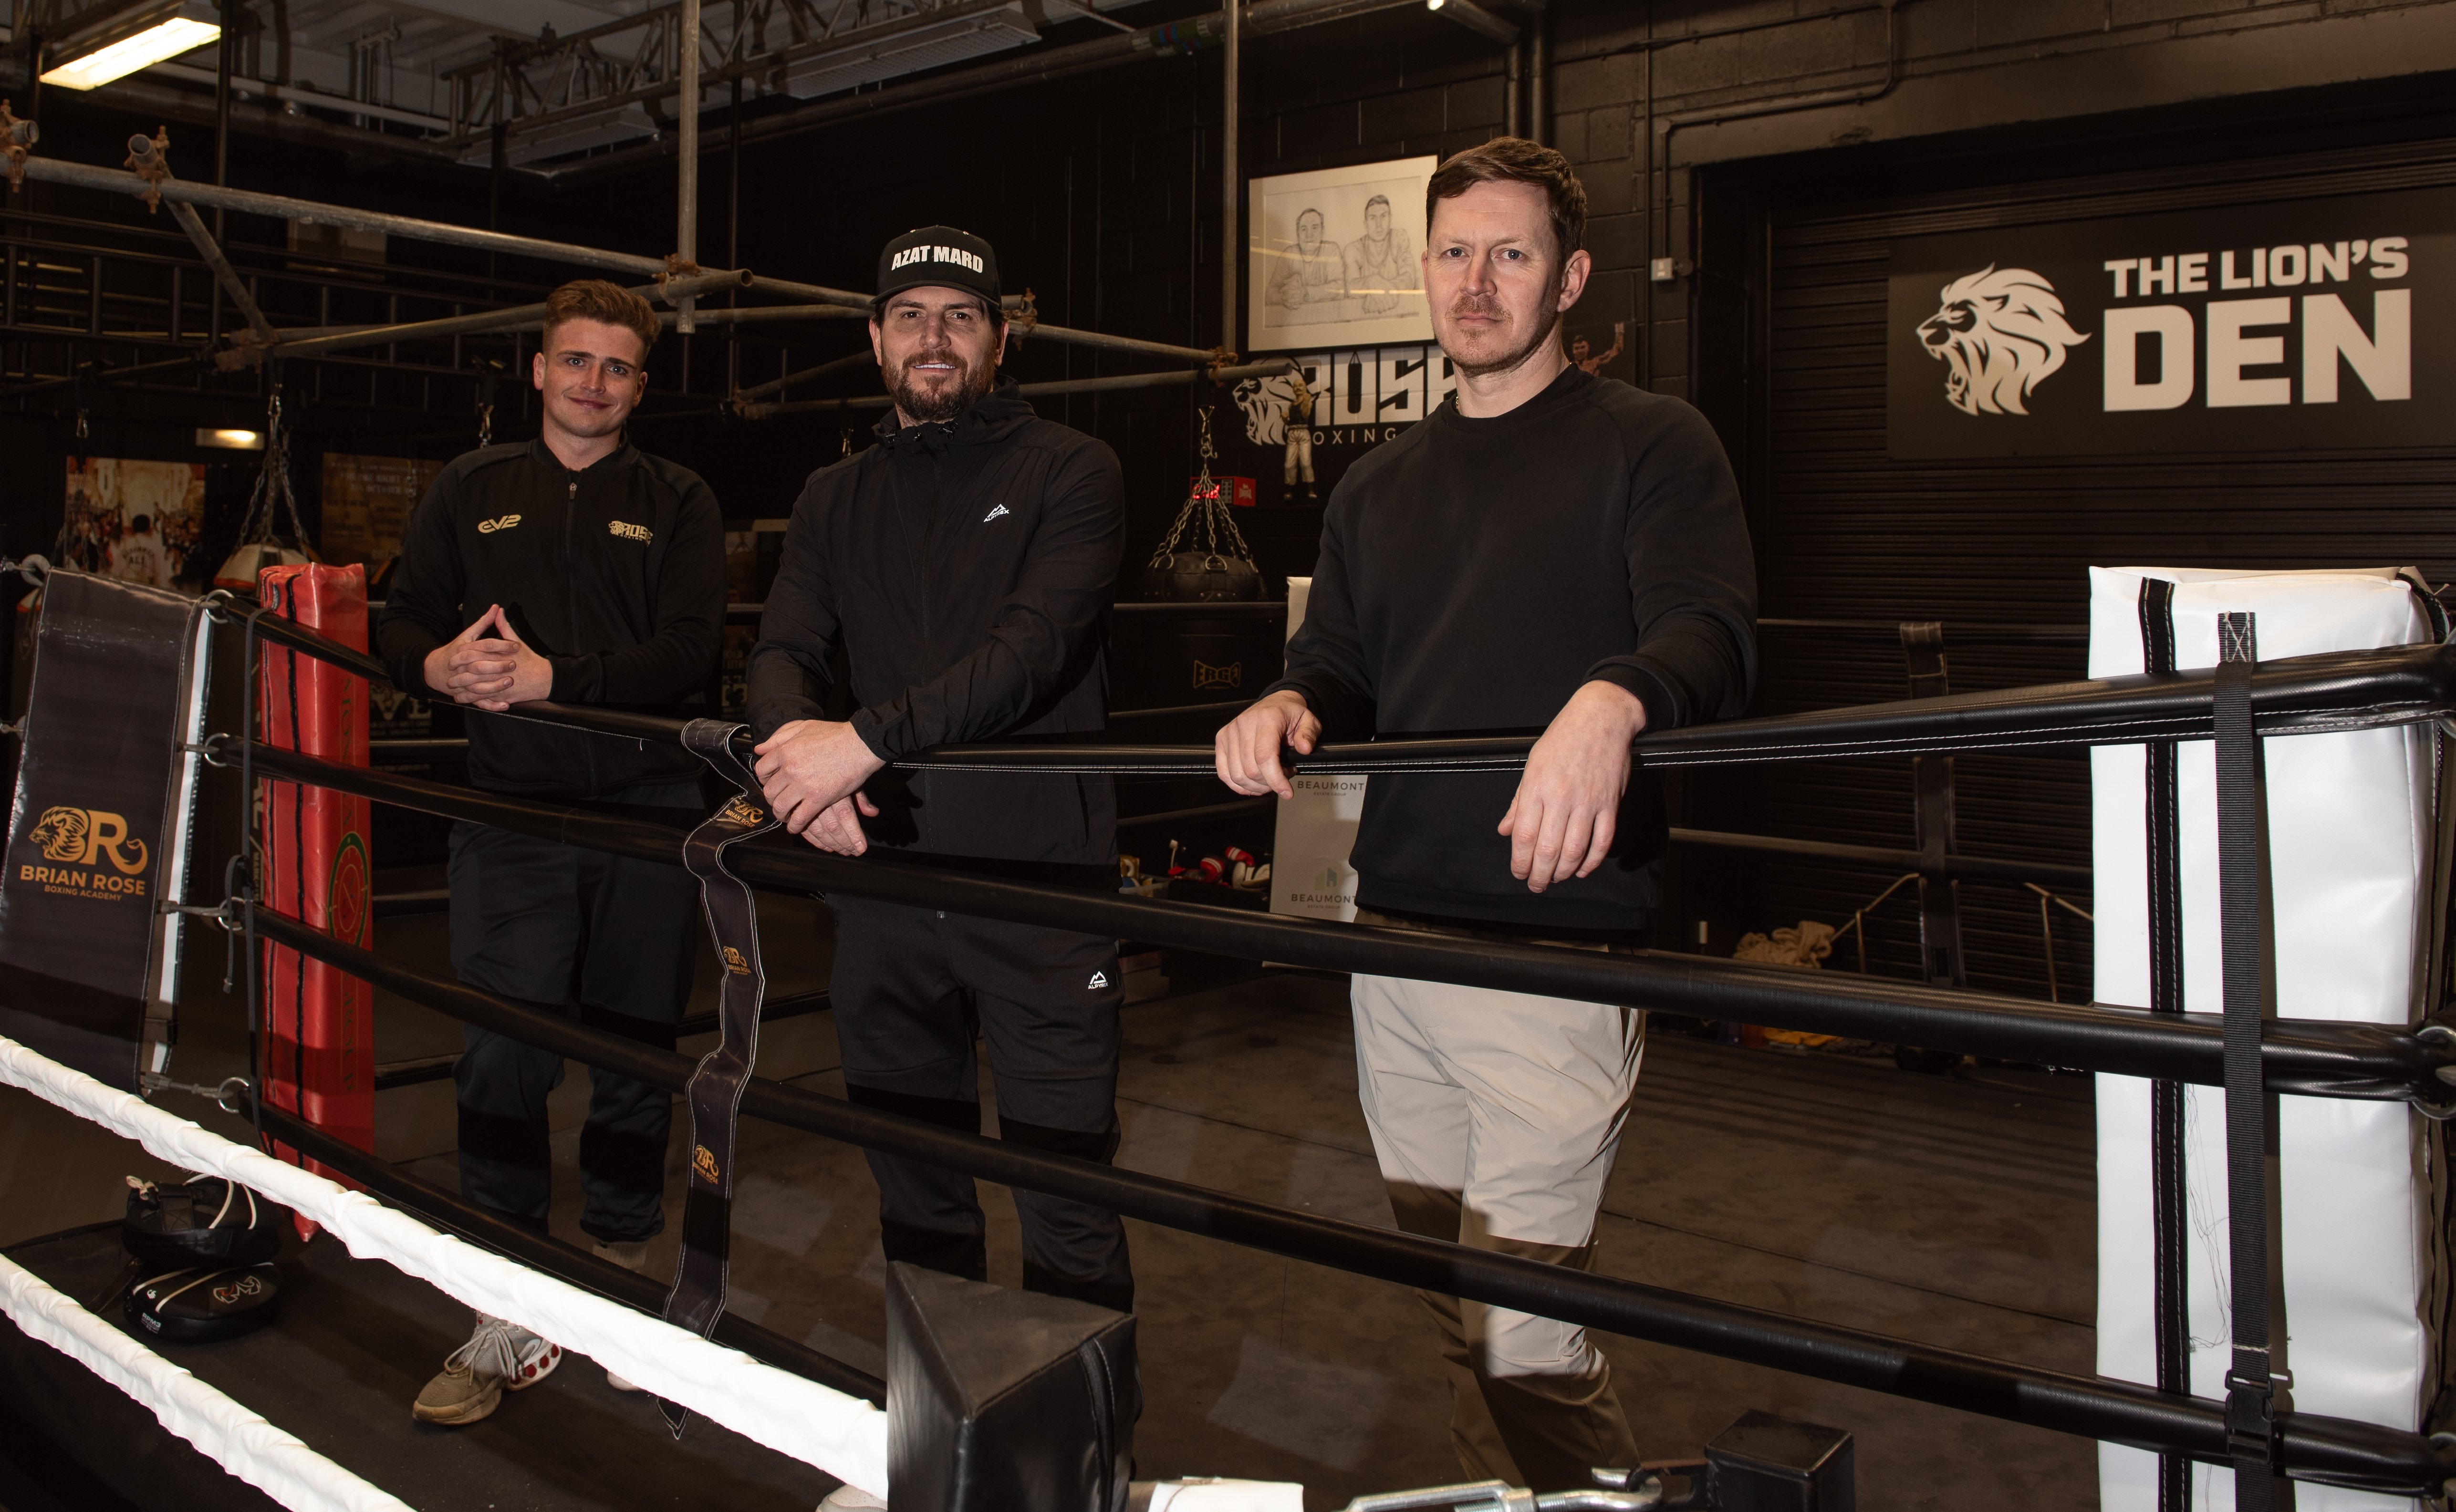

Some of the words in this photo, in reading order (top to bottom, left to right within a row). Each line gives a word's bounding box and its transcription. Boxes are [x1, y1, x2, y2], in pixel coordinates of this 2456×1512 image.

[891, 245, 931, 271] AZAT
[933, 246, 983, 274] MARD
[2104, 252, 2209, 299] THE
[2220, 236, 2409, 290] LION'S
[2102, 288, 2412, 413] DEN
[1311, 426, 1397, 446] OXING
[1297, 780, 1364, 791] BEAUMONT
[725, 809, 742, 821] BRIAN
[740, 818, 756, 828] ROSE
[20, 864, 87, 888] BRIAN
[93, 873, 146, 896] ROSE
[44, 884, 78, 896] BOXING
[80, 890, 122, 901] ACADEMY
[1291, 893, 1356, 903] BEAUMON
